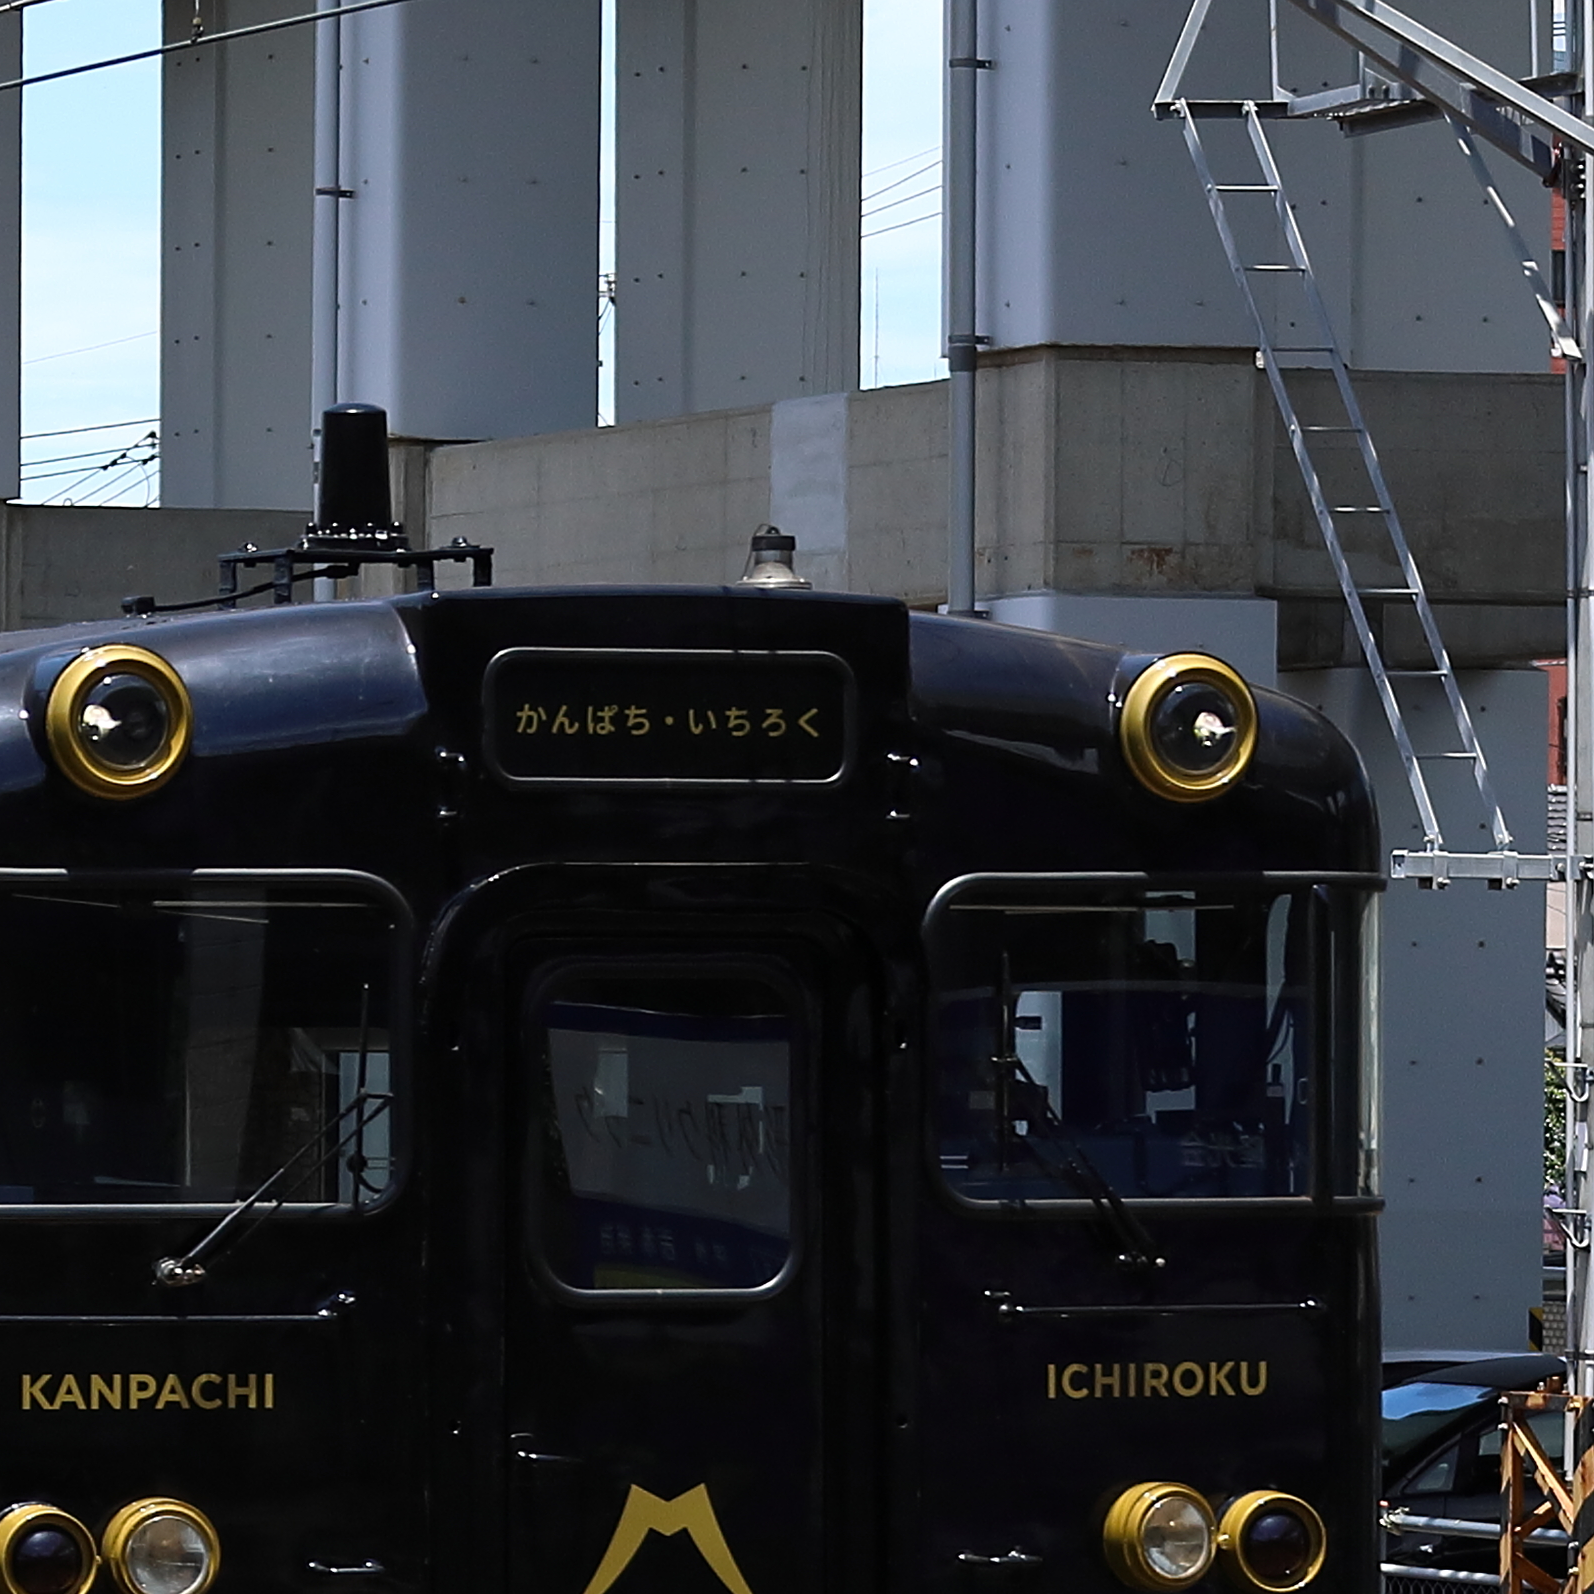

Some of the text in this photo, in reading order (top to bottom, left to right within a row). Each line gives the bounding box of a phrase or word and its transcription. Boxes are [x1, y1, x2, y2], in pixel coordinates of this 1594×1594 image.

[515, 703, 821, 738] かんぱち・いちろく
[20, 1373, 275, 1411] KANPACHI
[1046, 1360, 1269, 1400] ICHIROKU
